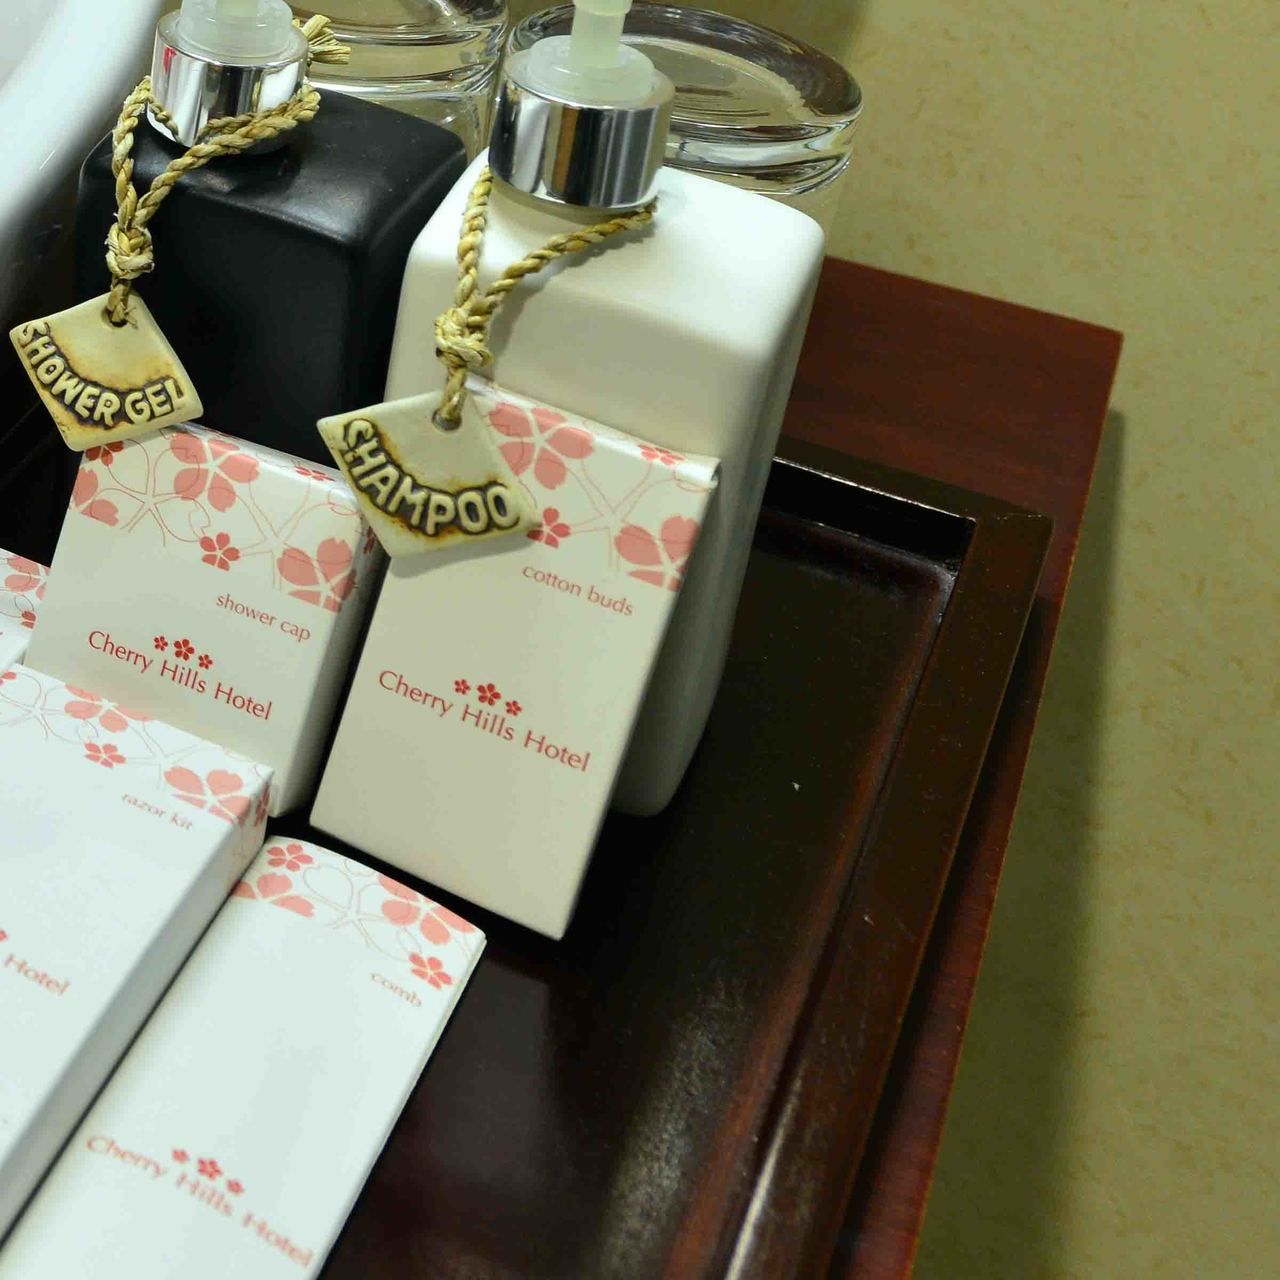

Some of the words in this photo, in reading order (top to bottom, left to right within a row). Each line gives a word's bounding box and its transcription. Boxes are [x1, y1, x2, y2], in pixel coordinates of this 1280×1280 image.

[19, 321, 120, 427] SHOWER
[125, 377, 184, 424] GEL
[344, 419, 519, 535] SHAMPOO
[216, 593, 276, 626] shower
[280, 620, 311, 642] cap
[522, 566, 582, 596] cotton
[588, 585, 634, 616] buds
[89, 631, 153, 674] Cherry
[160, 659, 206, 694] Hills
[214, 682, 273, 721] Hotel
[379, 670, 453, 717] Cherry
[461, 704, 514, 741] Hills
[523, 730, 591, 772] Hotel
[4, 954, 70, 995] Hotel
[86, 1136, 167, 1180] Cherry
[176, 1172, 233, 1217] Hills
[243, 1211, 314, 1268] Hotel
